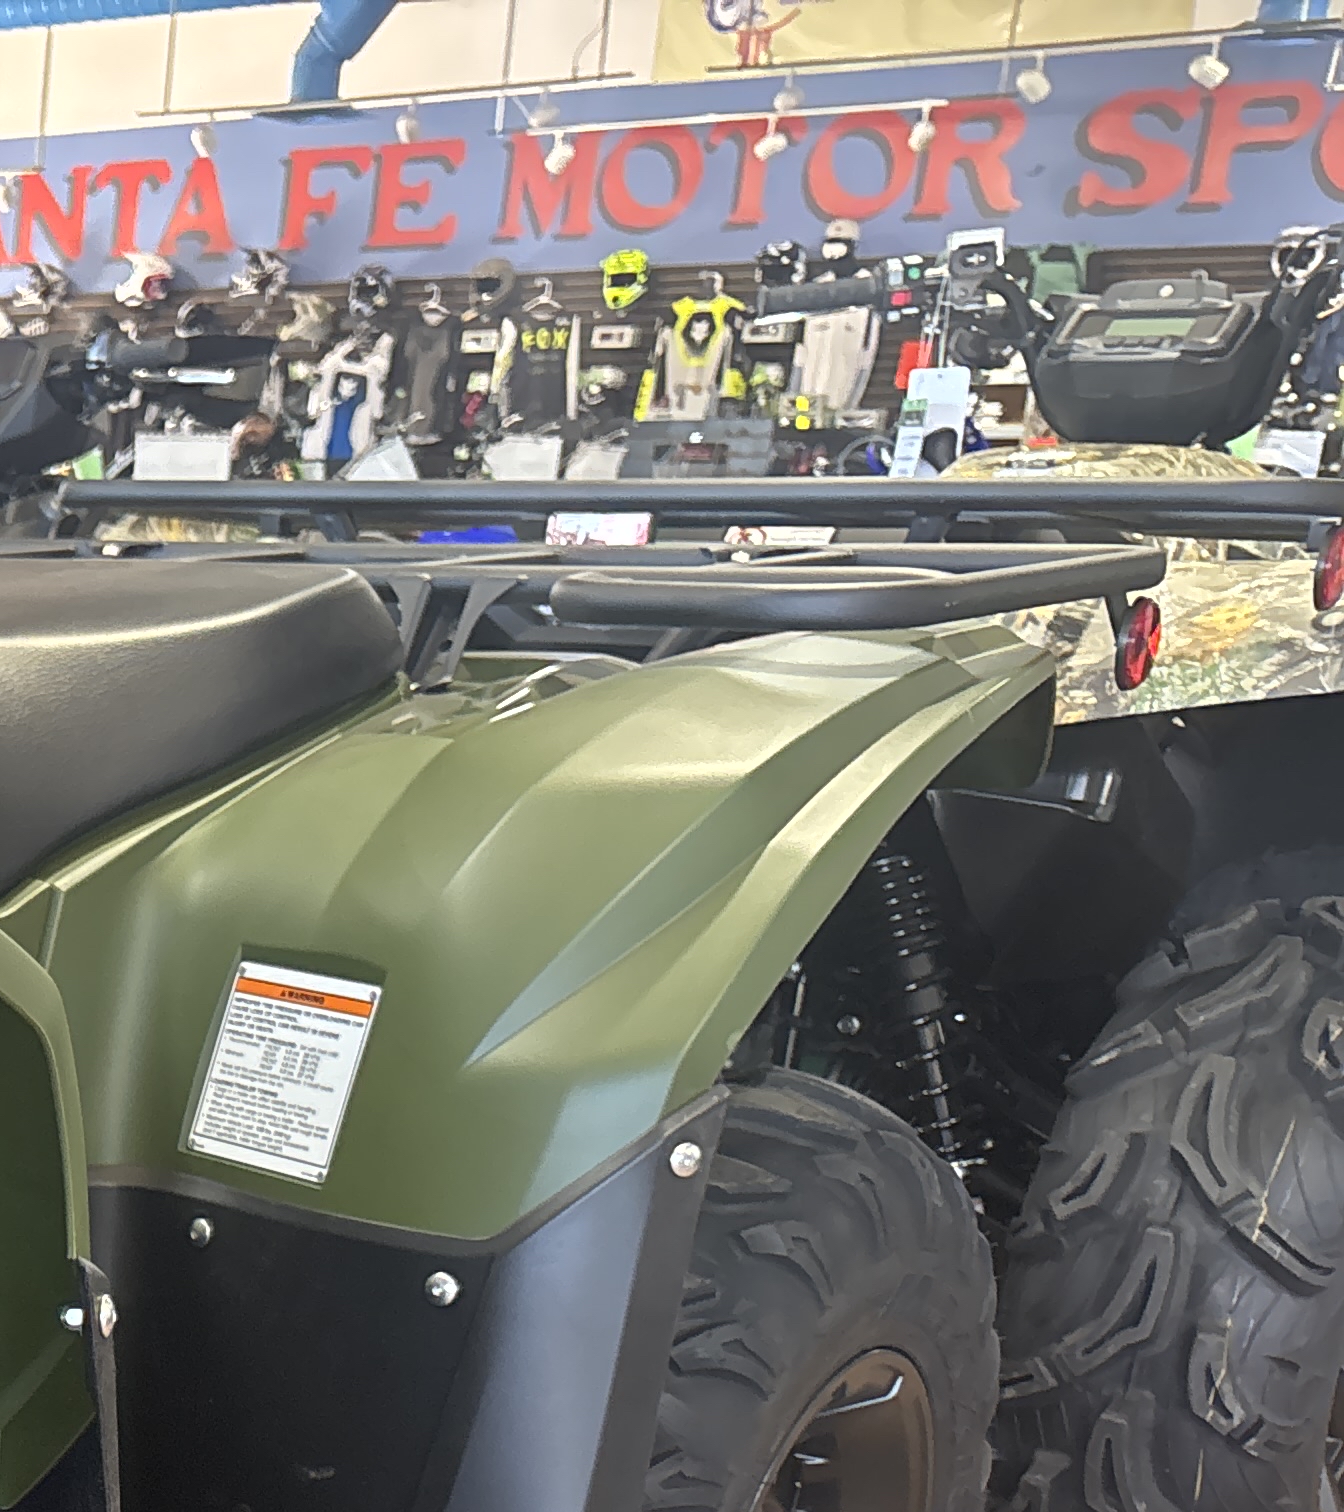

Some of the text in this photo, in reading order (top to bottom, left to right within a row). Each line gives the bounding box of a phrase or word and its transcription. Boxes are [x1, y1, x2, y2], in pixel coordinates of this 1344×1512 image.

[280, 139, 466, 252] FE
[494, 97, 1030, 244] MOTOR
[1076, 78, 1344, 211] SP
